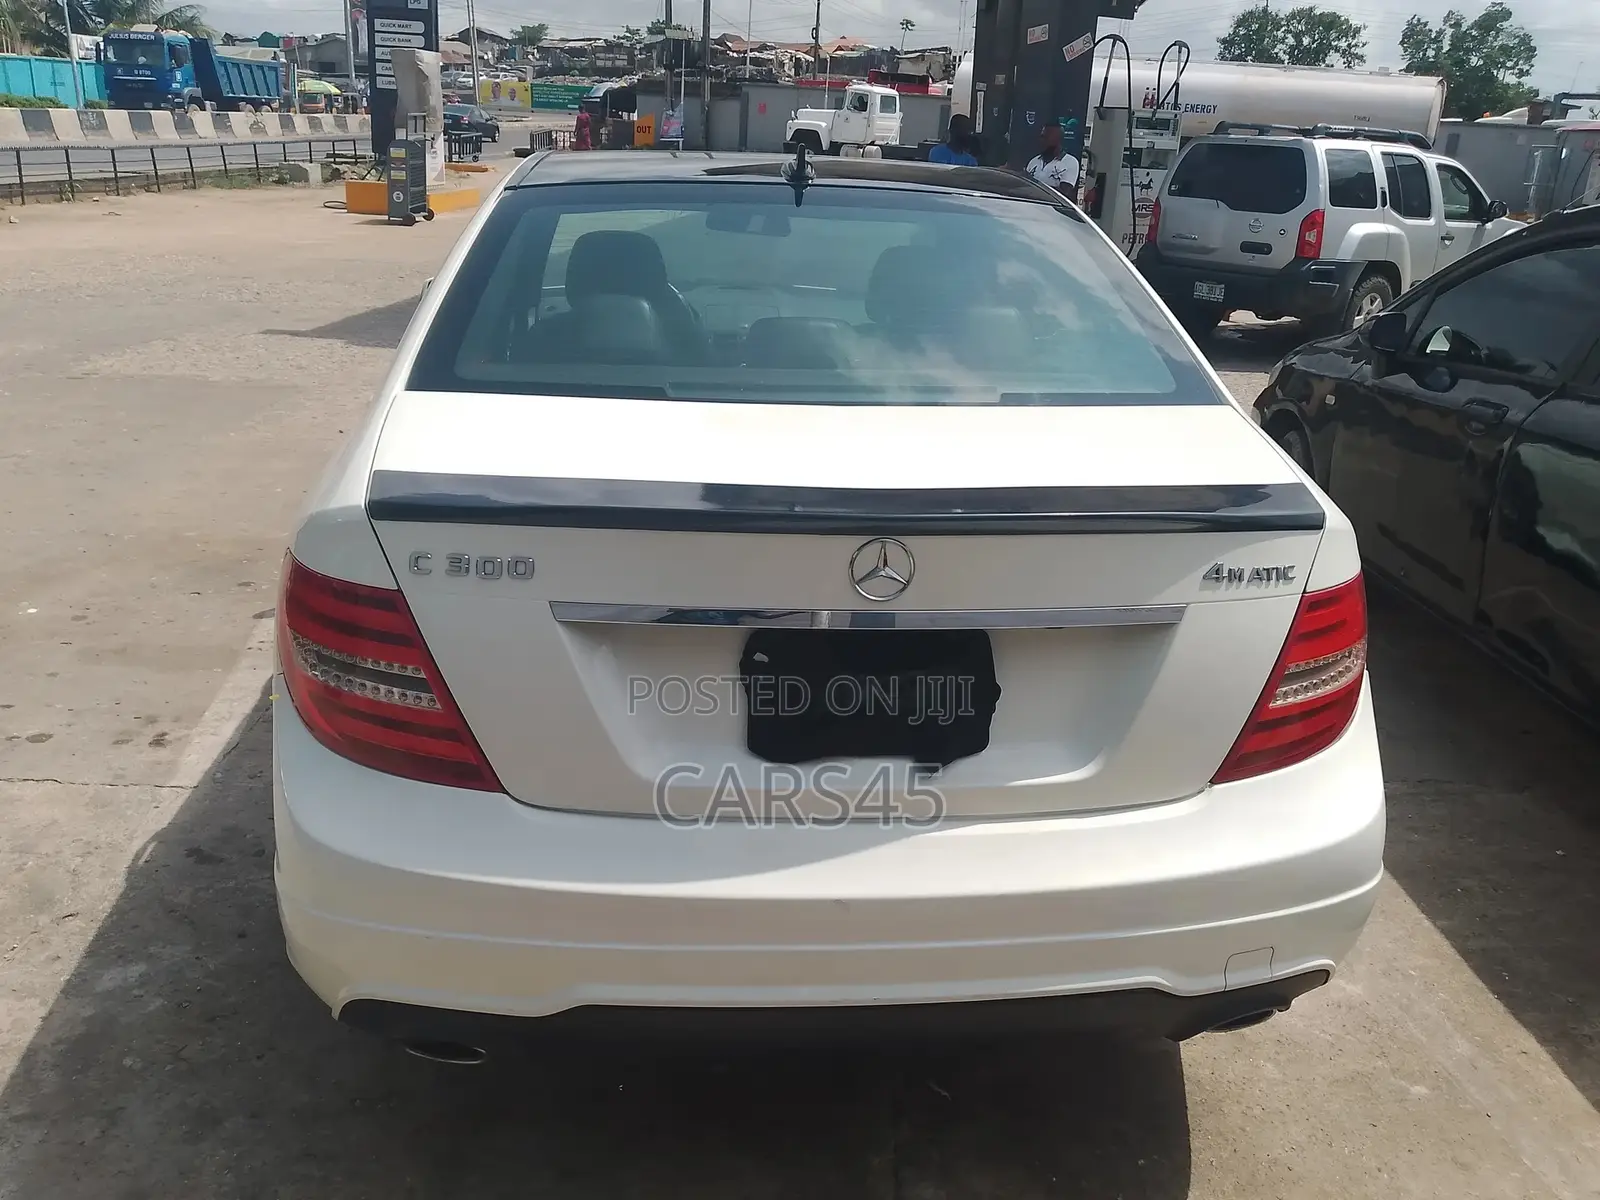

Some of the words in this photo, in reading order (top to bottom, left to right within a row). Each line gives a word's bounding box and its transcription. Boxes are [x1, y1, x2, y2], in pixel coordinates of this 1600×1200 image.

[1184, 103, 1218, 114] ENERGY
[636, 125, 652, 134] OUT
[409, 551, 433, 575] C
[445, 553, 535, 579] 300
[1202, 562, 1296, 583] 4MATIC
